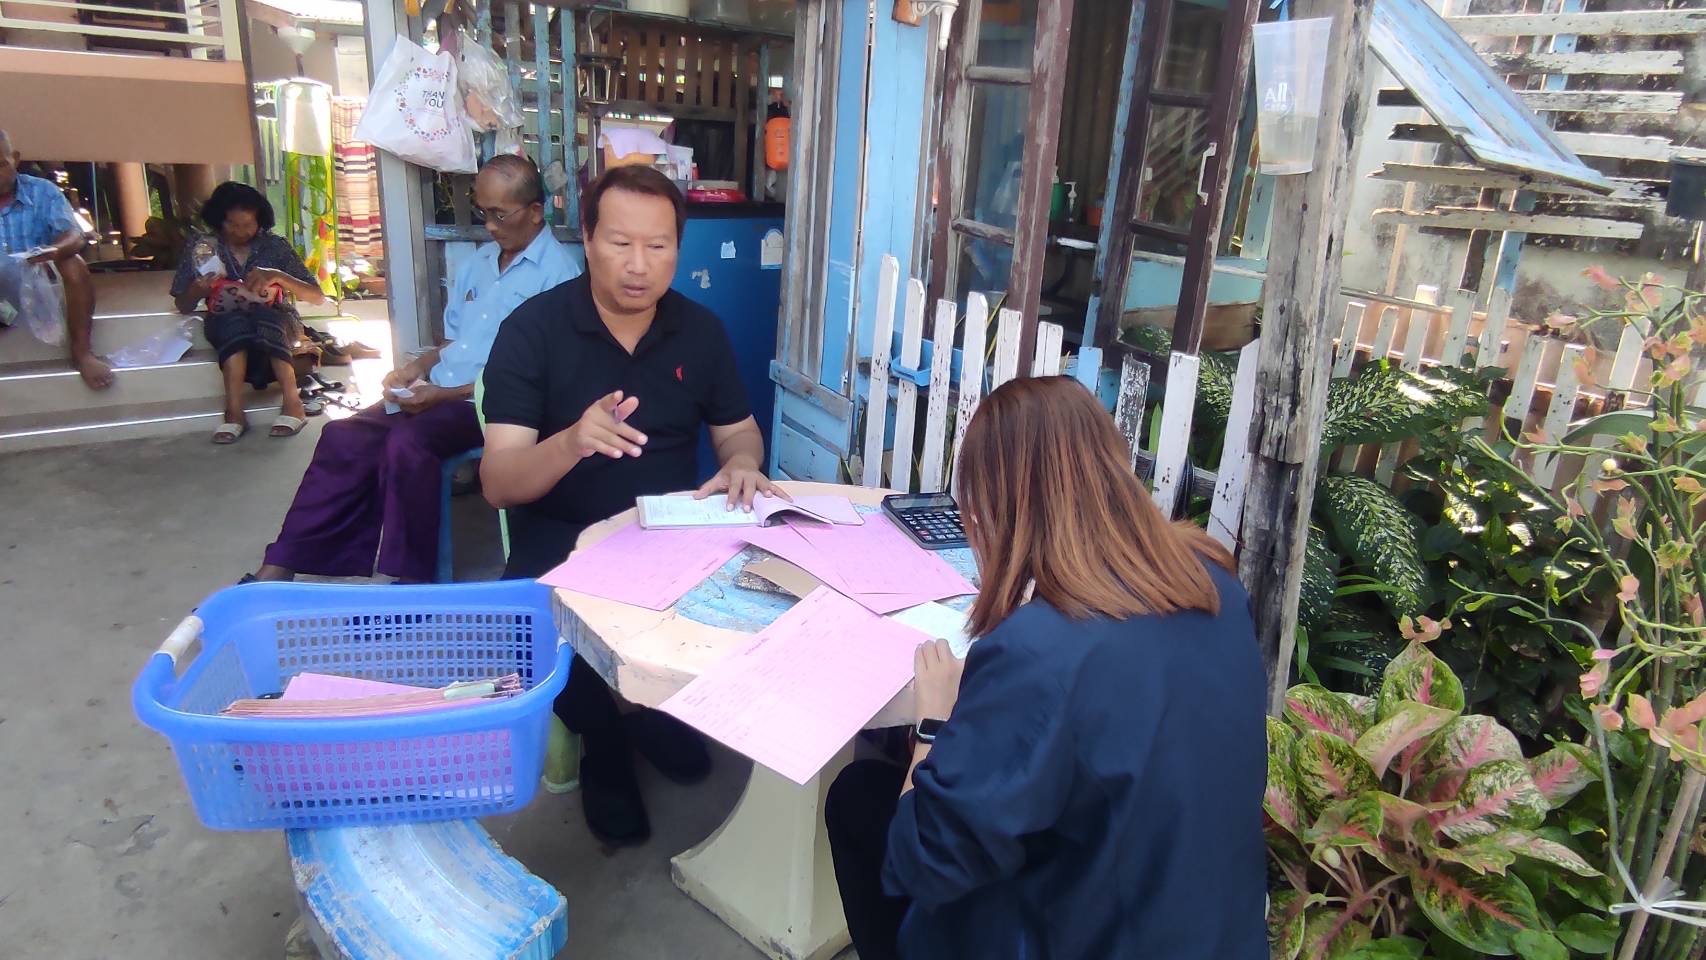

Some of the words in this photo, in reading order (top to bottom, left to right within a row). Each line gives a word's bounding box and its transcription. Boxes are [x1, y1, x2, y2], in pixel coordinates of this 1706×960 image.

[422, 90, 446, 100] THAN
[1263, 82, 1288, 103] All
[424, 98, 444, 108] YOU
